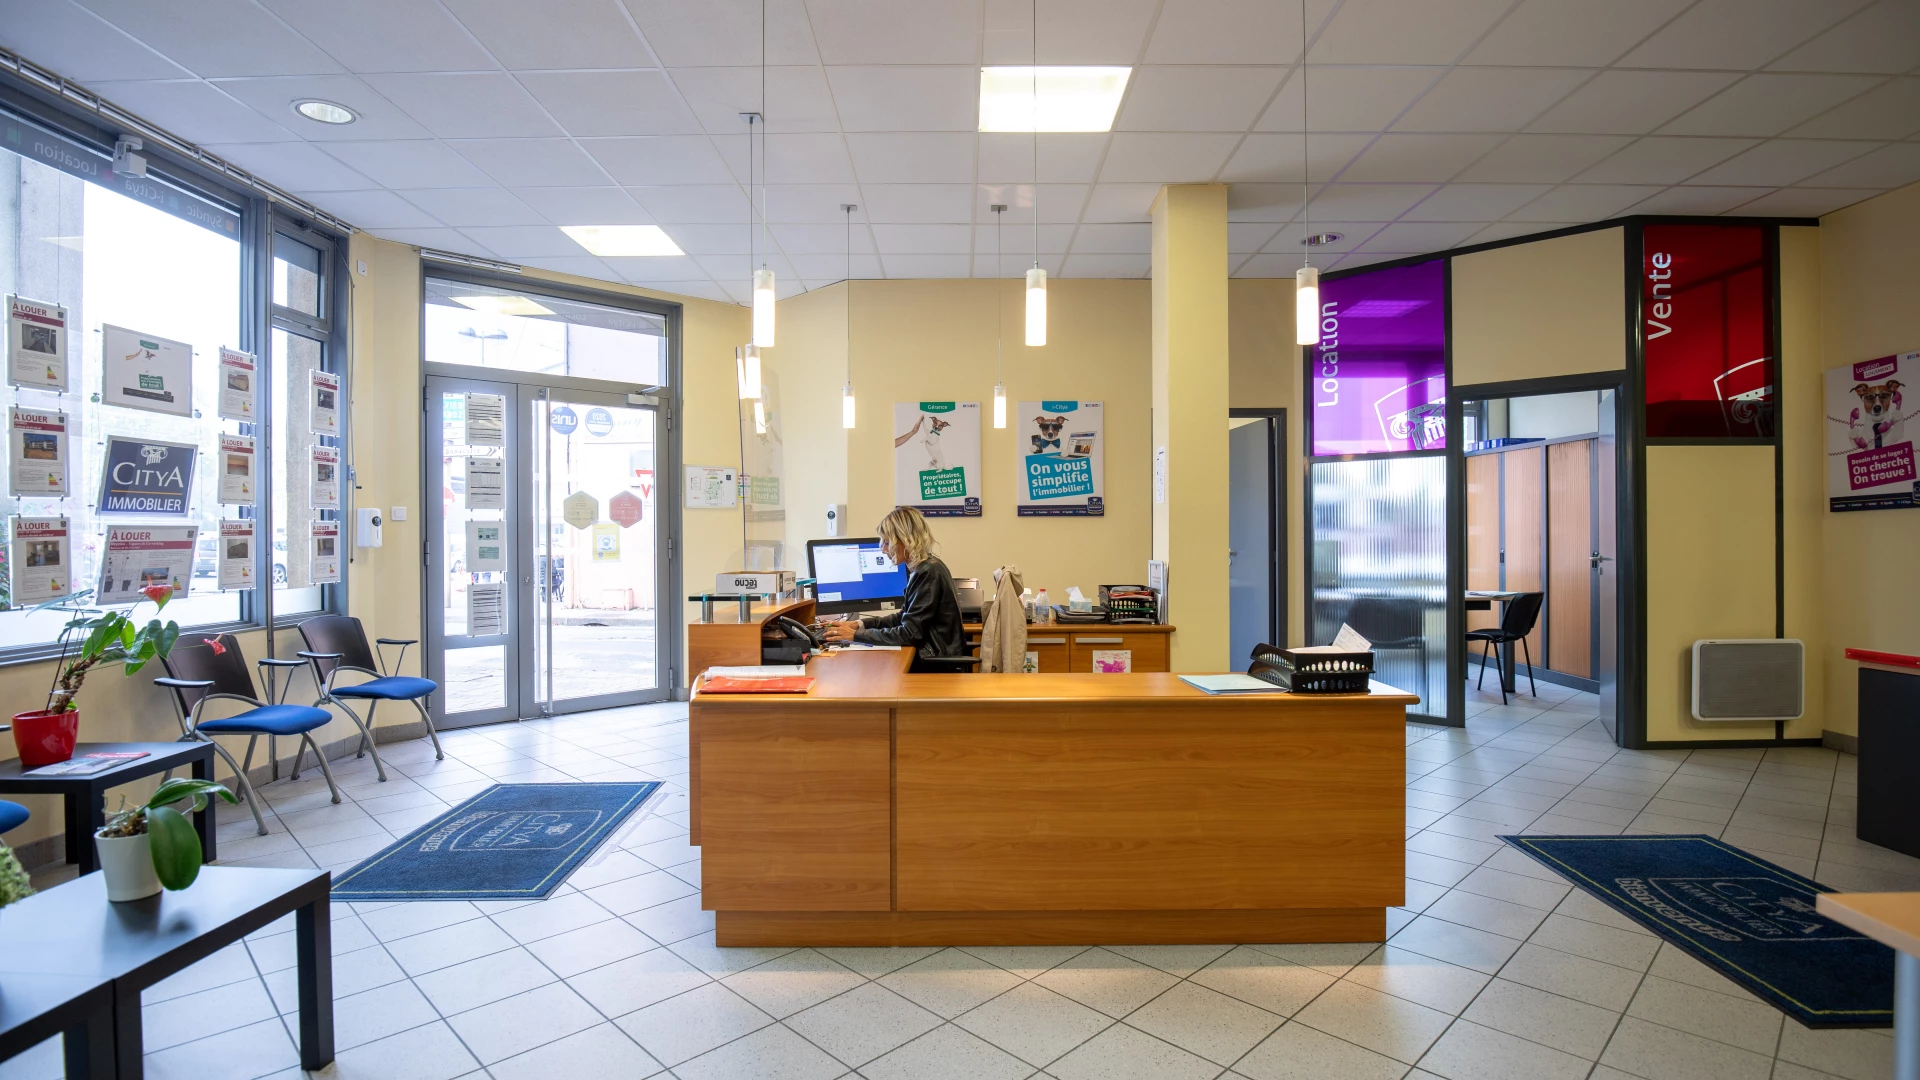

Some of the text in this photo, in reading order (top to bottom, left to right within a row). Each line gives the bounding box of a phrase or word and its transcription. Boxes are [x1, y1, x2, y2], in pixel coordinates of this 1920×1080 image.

[1647, 252, 1672, 341] Vente
[12, 301, 19, 311] À
[20, 304, 47, 316] LOUER
[226, 353, 243, 363] LOUER
[1317, 301, 1339, 408] Location
[1855, 363, 1880, 374] Location
[1865, 365, 1892, 377] LOGEMENT
[13, 411, 48, 424] À LOUER
[1851, 456, 1871, 465] Besoin
[1887, 449, 1904, 458] loger
[1030, 460, 1088, 476] On vous
[1852, 456, 1910, 475] On cherche
[934, 477, 962, 486] s'occupe
[1031, 471, 1089, 488] simplifie
[1853, 464, 1912, 485] On trouve !
[924, 486, 936, 496] de
[937, 484, 958, 495] tout
[959, 483, 963, 492] !
[1032, 482, 1091, 497] l'immobilier !
[107, 496, 182, 511] IMMOBILIER
[16, 521, 50, 530] À LOUER
[110, 529, 151, 541] À LOUER
[734, 579, 758, 589] tecno
[1670, 882, 1783, 935] IMMOBILIER
